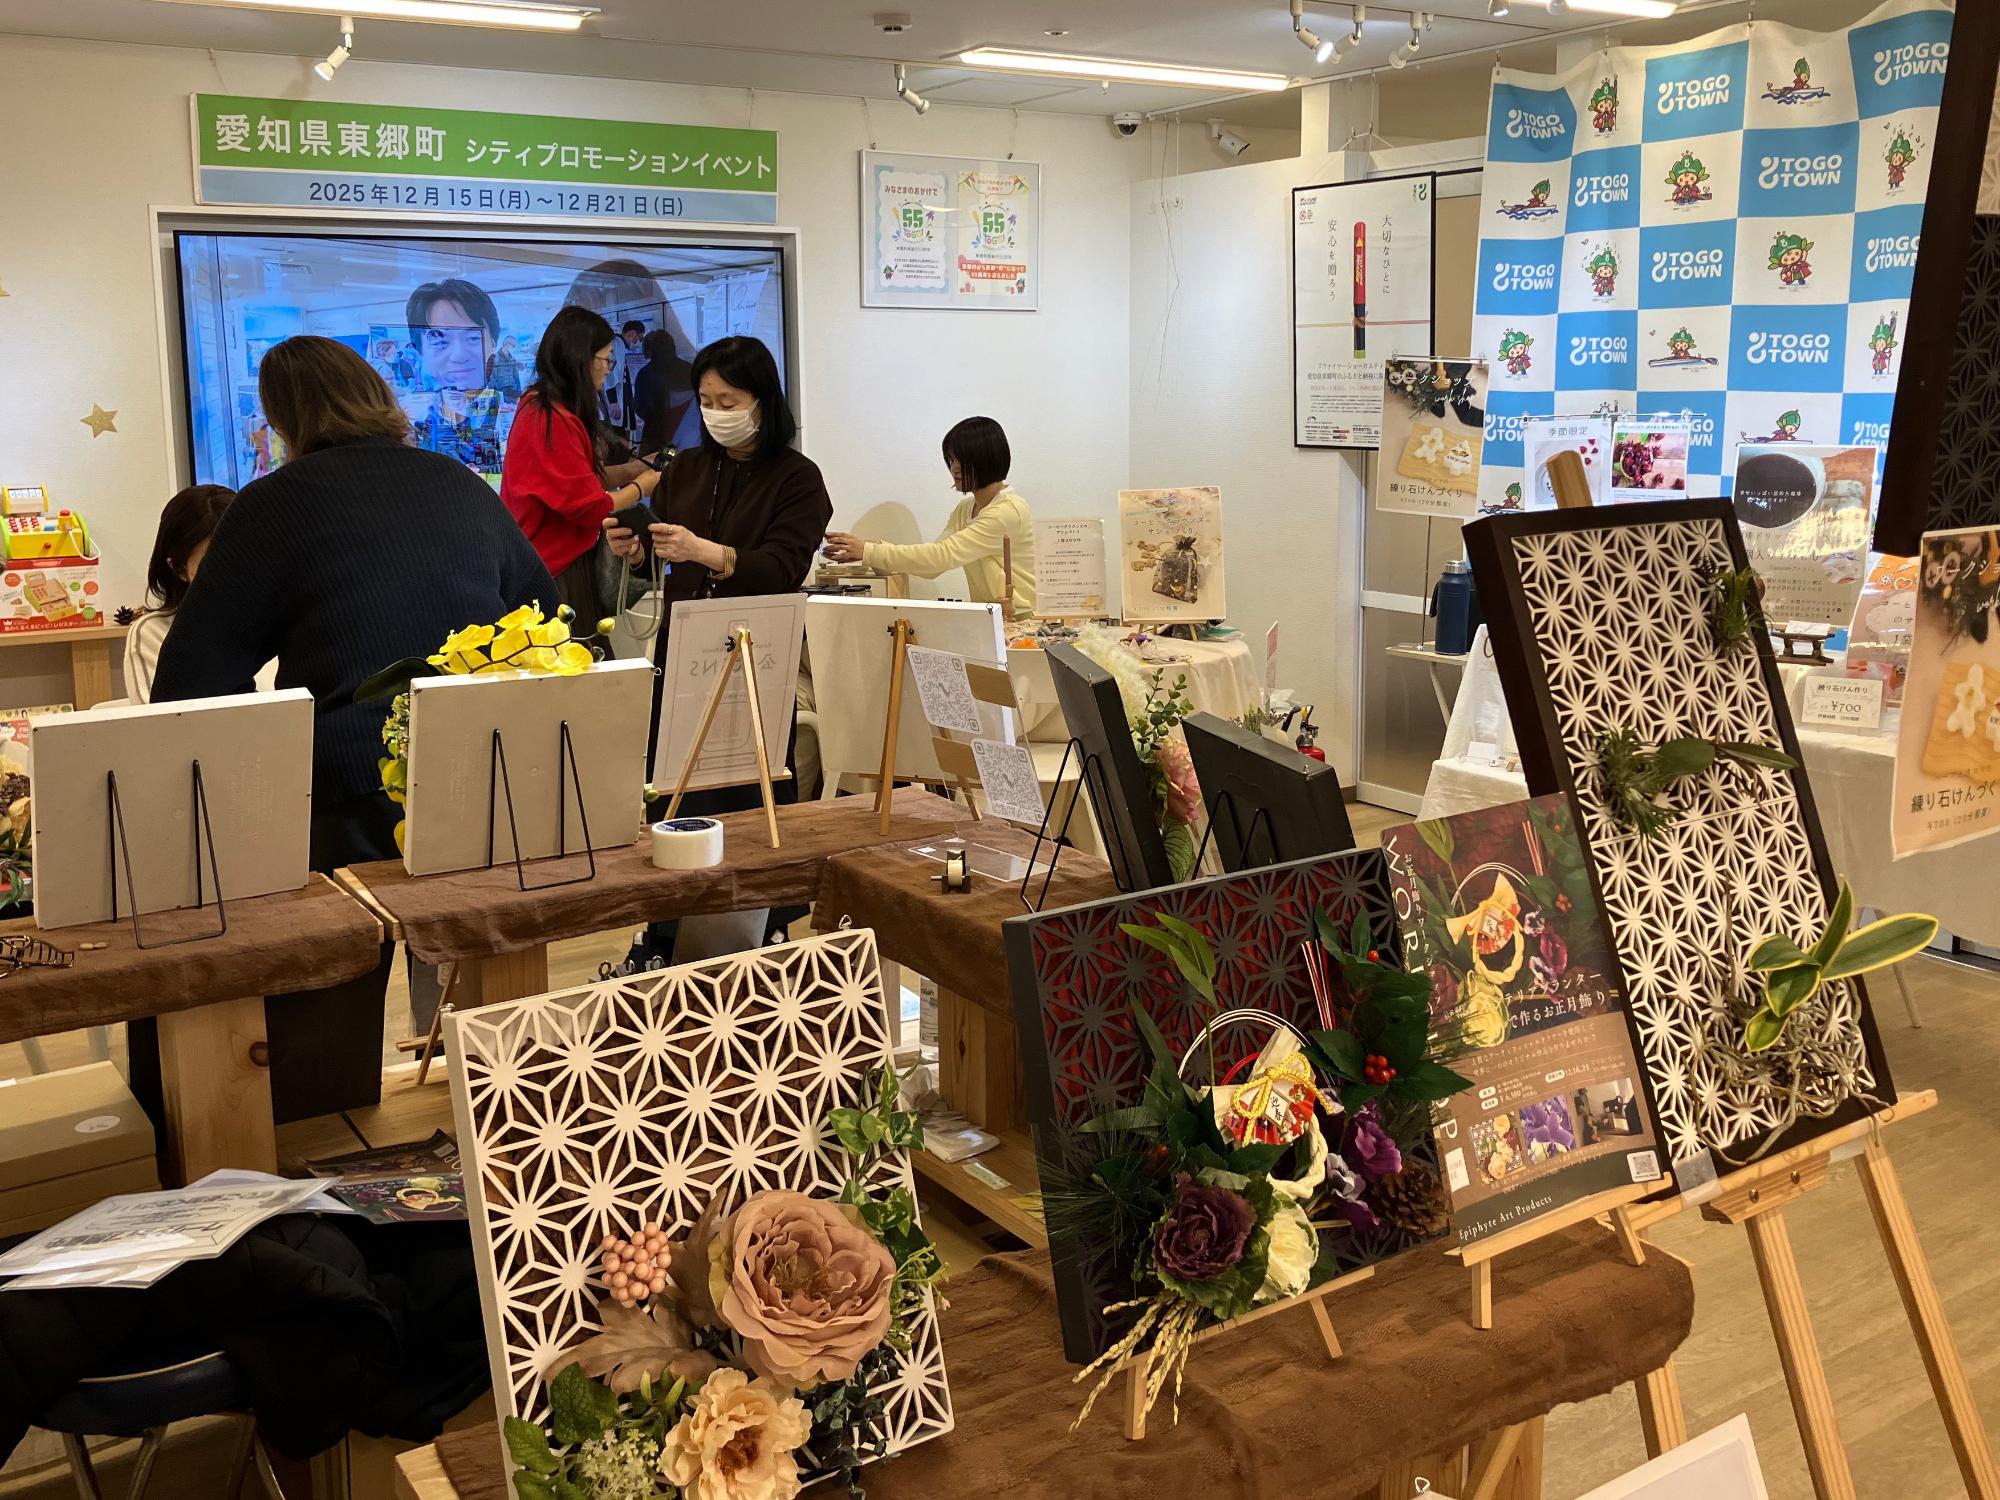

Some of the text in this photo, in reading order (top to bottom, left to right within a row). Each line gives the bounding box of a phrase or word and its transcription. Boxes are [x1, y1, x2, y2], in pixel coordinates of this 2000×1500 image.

[1893, 42, 1949, 61] TOGO
[1892, 57, 1948, 79] TOWN
[1674, 75, 1730, 94] TOGO
[1674, 89, 1730, 109] TOWN
[1523, 110, 1561, 127] TOGO
[1521, 123, 1565, 139] TOWN
[216, 114, 772, 179] 愛知県東郷町 シティプロモーションイベント
[1780, 155, 1842, 172] TOGO
[1588, 174, 1629, 190] TOGO
[1780, 169, 1841, 187] TOWN
[1588, 188, 1629, 204] TOWN
[1327, 219, 1337, 303] 安心を贈ろう
[1382, 214, 1392, 295] 大切なひとに
[1668, 249, 1723, 266] TOGO
[1511, 264, 1555, 280] TOGO
[1668, 264, 1723, 281] TOWN
[1509, 276, 1554, 292] TOWN
[1588, 337, 1628, 353] TOGO
[1769, 334, 1831, 350] TOGO
[1588, 349, 1628, 365] TOWN
[1768, 348, 1830, 364] TOWN
[1548, 426, 1589, 438] 季節限定
[1865, 423, 1890, 438] TOG
[1390, 483, 1463, 498] 練り石けんづくり
[1880, 600, 1912, 609] コーヒ
[1911, 779, 1997, 814] 練り石けんづく
[1459, 1194, 1553, 1241] Epiphyte Art Products
